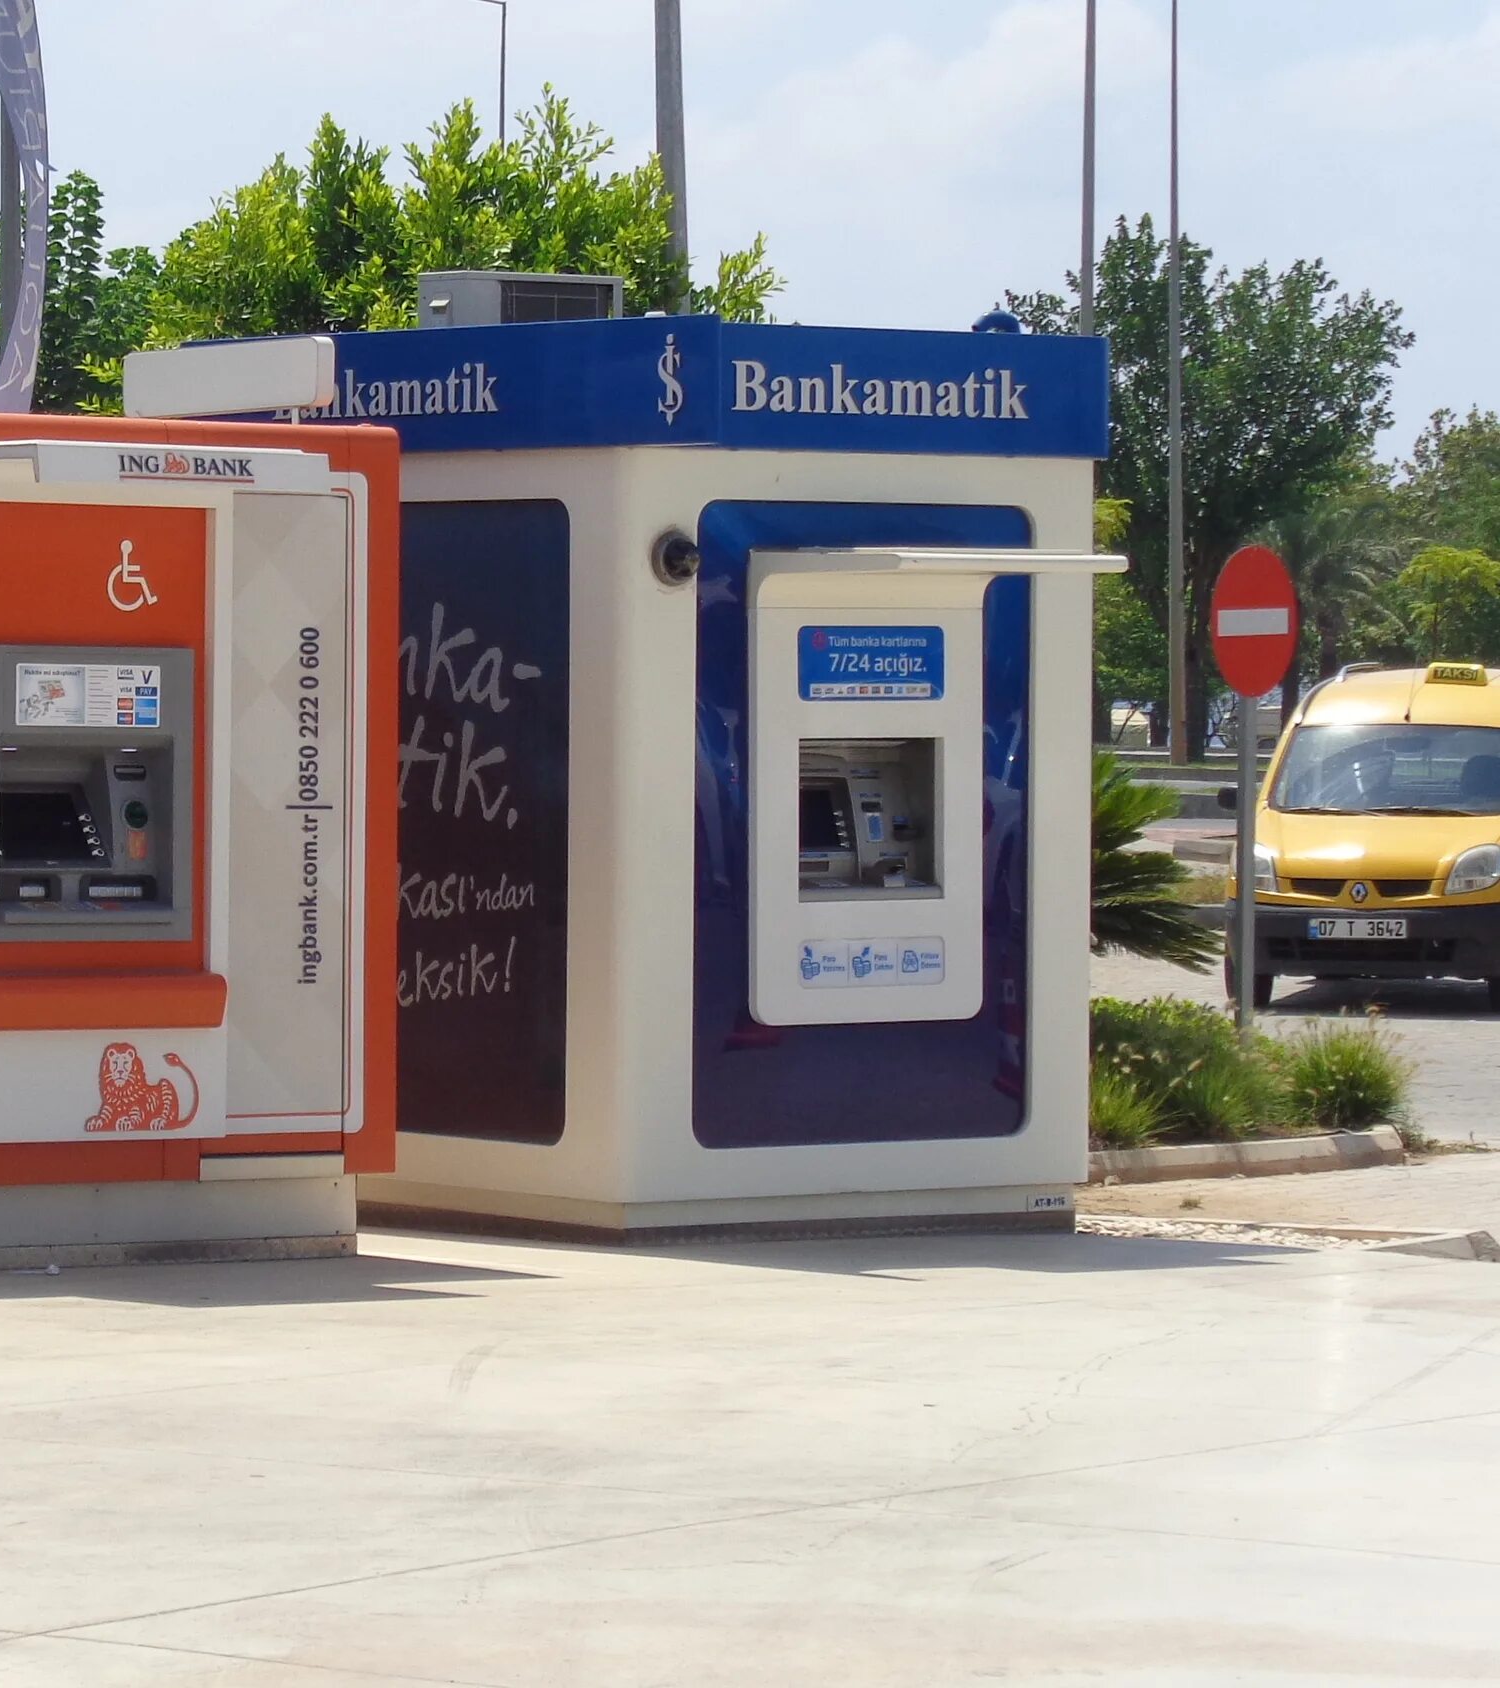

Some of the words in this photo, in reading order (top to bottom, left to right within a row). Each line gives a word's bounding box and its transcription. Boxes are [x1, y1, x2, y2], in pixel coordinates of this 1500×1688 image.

[272, 362, 499, 420] nkamatik
[731, 360, 1029, 419] Bankamatik
[118, 454, 159, 474] ING
[193, 457, 254, 477] BANK
[300, 626, 321, 669] 600
[828, 636, 849, 647] Tüm
[850, 636, 880, 647] banka
[300, 675, 320, 690] 0
[829, 653, 871, 672] 7/24
[874, 653, 927, 676] açığız.
[299, 695, 320, 739] 222
[299, 745, 320, 802] 0850
[297, 814, 323, 984] ingbank.com.tr
[1318, 921, 1336, 937] 07
[1347, 921, 1355, 937] T
[1367, 921, 1404, 937] 3642
